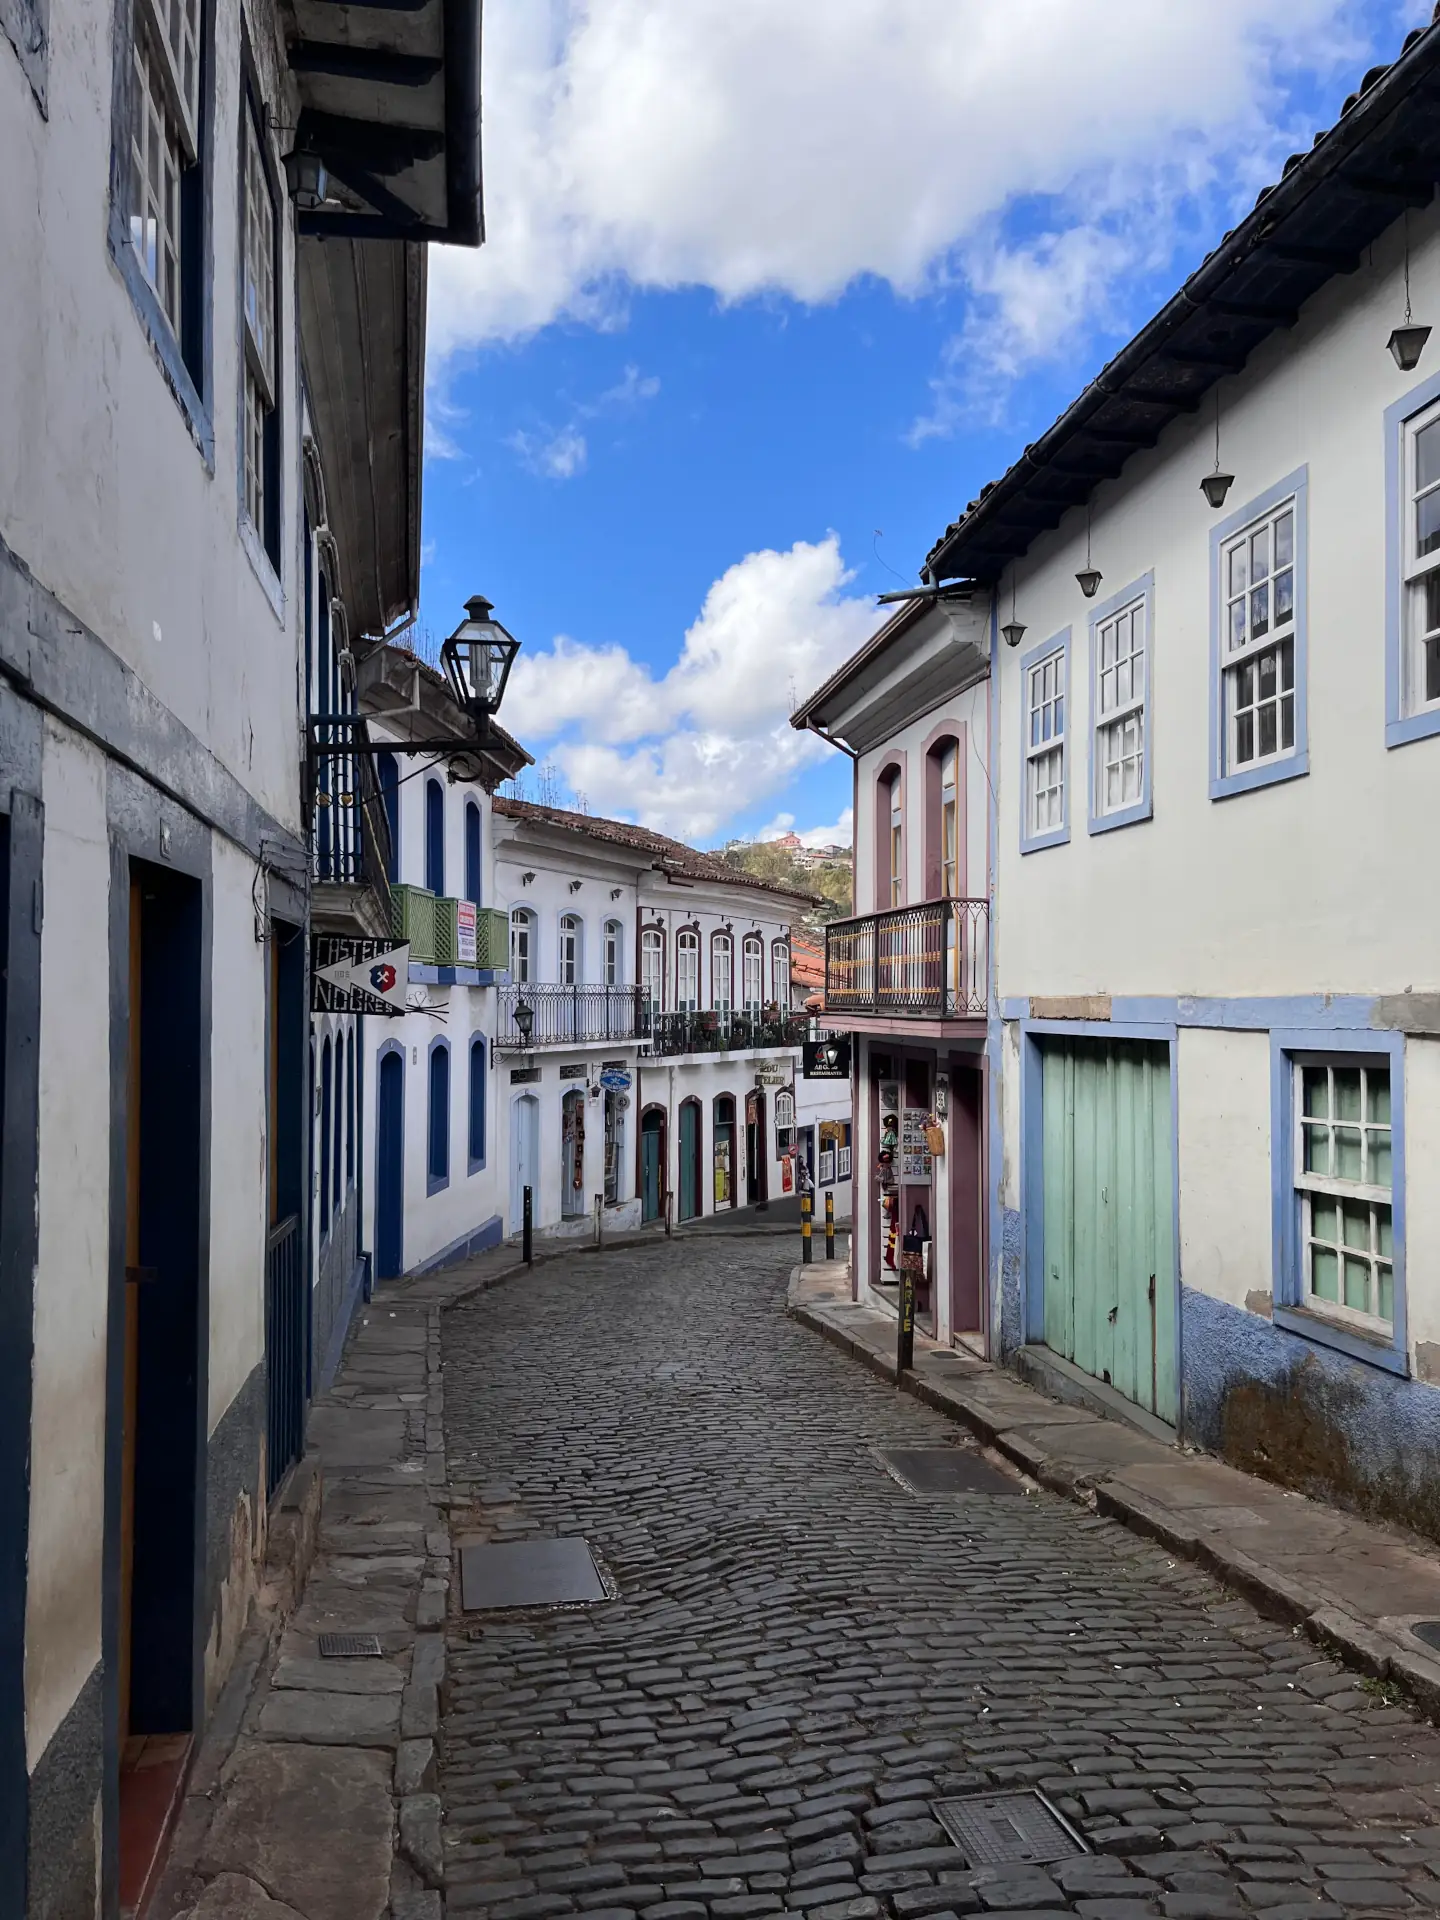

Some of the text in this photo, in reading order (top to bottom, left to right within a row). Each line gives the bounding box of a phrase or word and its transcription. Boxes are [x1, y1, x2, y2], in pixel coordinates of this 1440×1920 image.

[316, 937, 392, 970] CASTELO
[315, 978, 392, 1012] NOBRES
[904, 1276, 912, 1332] ARTE
